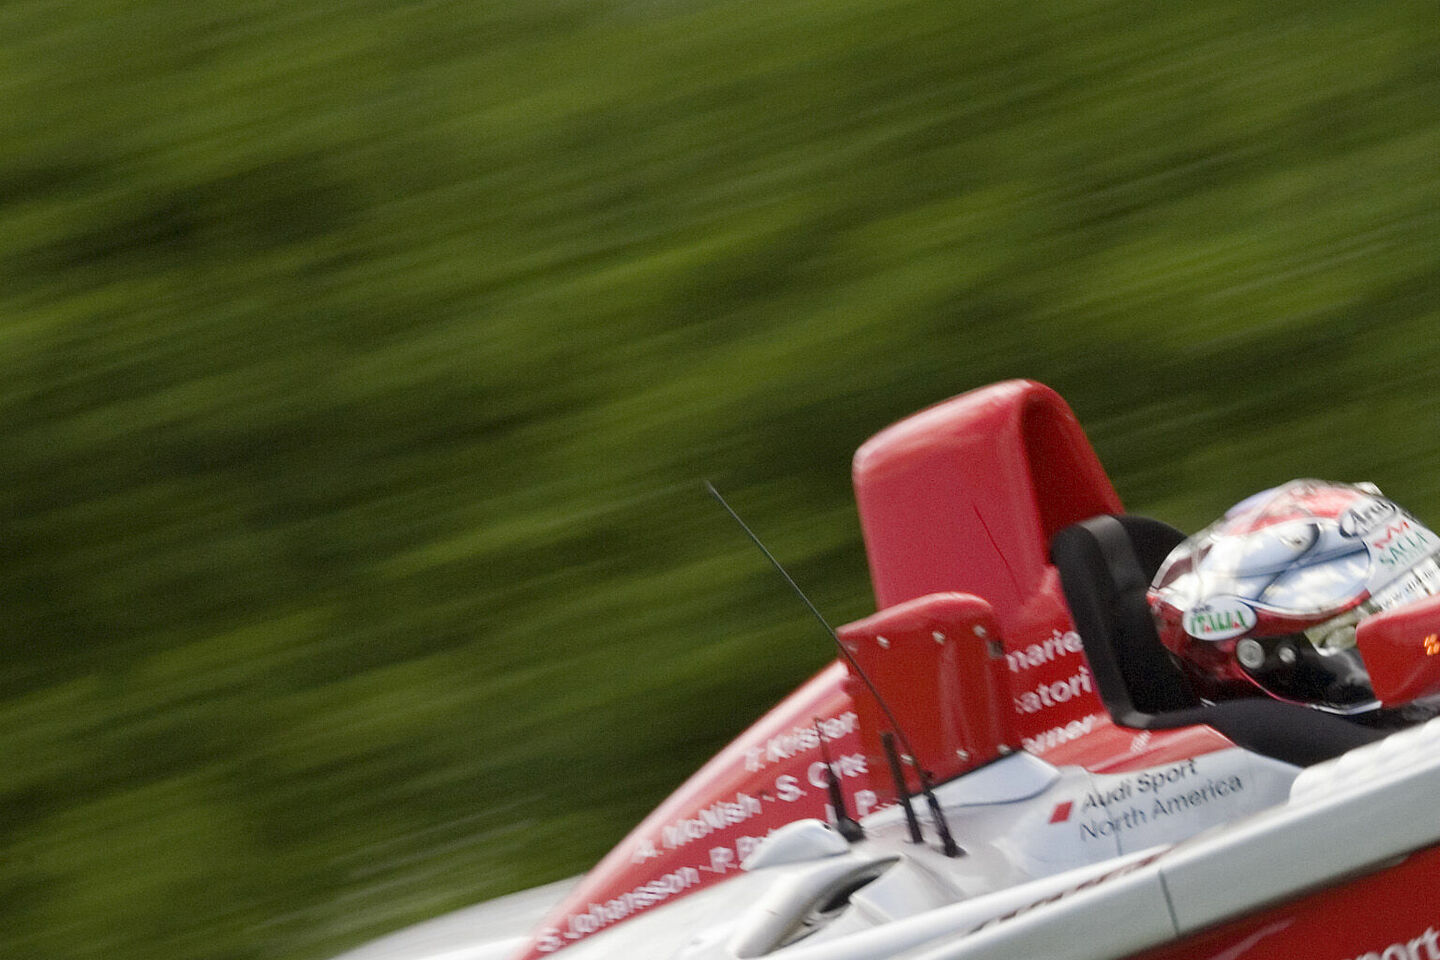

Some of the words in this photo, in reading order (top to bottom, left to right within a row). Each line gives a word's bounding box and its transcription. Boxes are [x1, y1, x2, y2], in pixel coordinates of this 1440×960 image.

[775, 774, 808, 803] S.
[1079, 806, 1147, 842] North
[1152, 773, 1244, 820] America
[1081, 778, 1132, 814] Audi
[1136, 757, 1198, 794] Sport
[564, 866, 700, 939] Johansson
